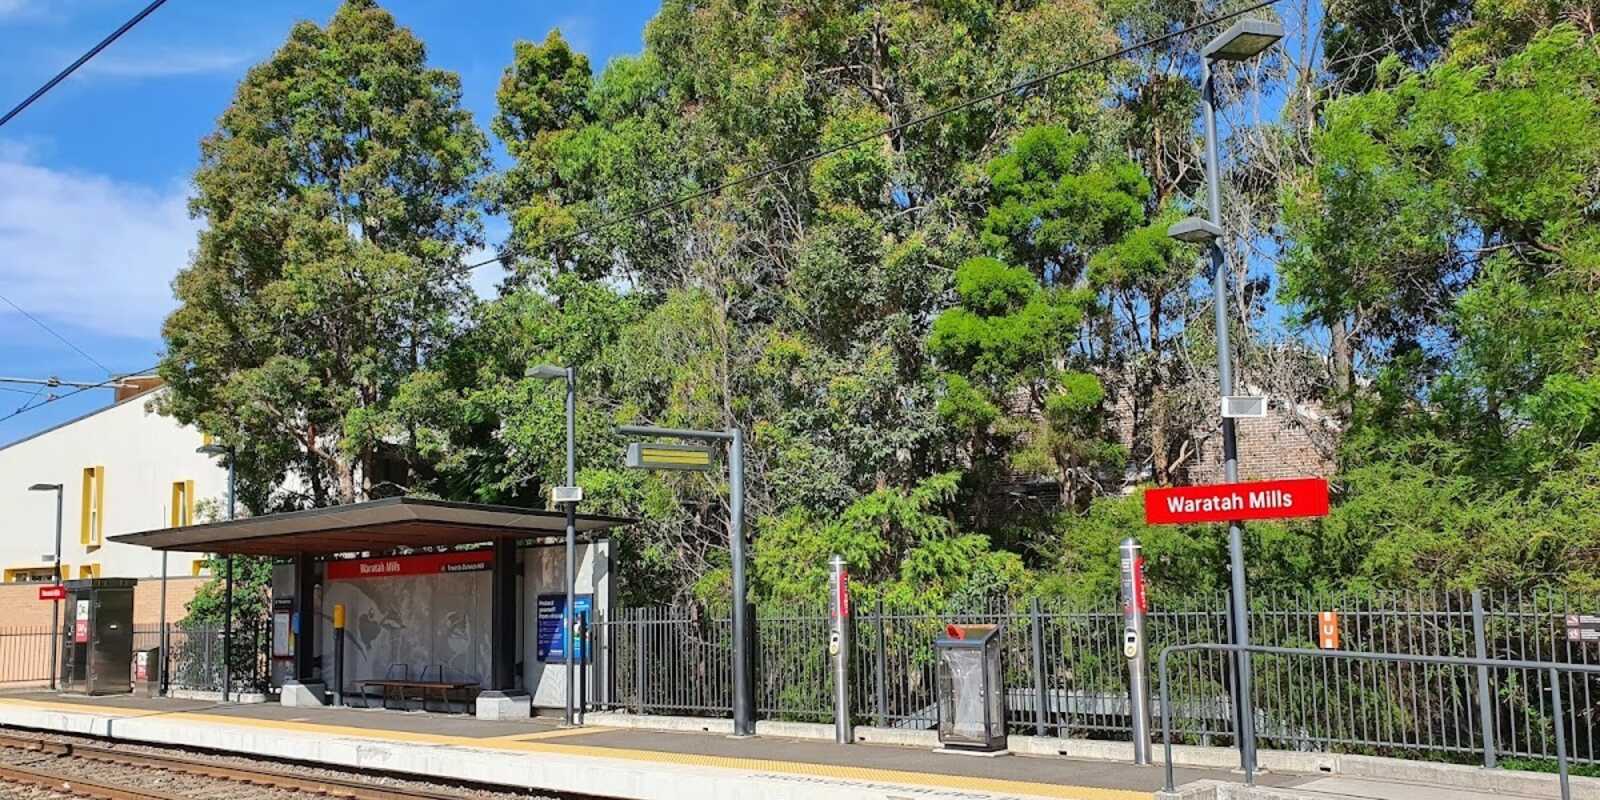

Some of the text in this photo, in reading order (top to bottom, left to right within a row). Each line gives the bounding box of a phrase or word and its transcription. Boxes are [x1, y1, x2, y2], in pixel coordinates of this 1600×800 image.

[1167, 490, 1293, 513] Waratah Mills
[360, 561, 400, 573] Waratah Mills
